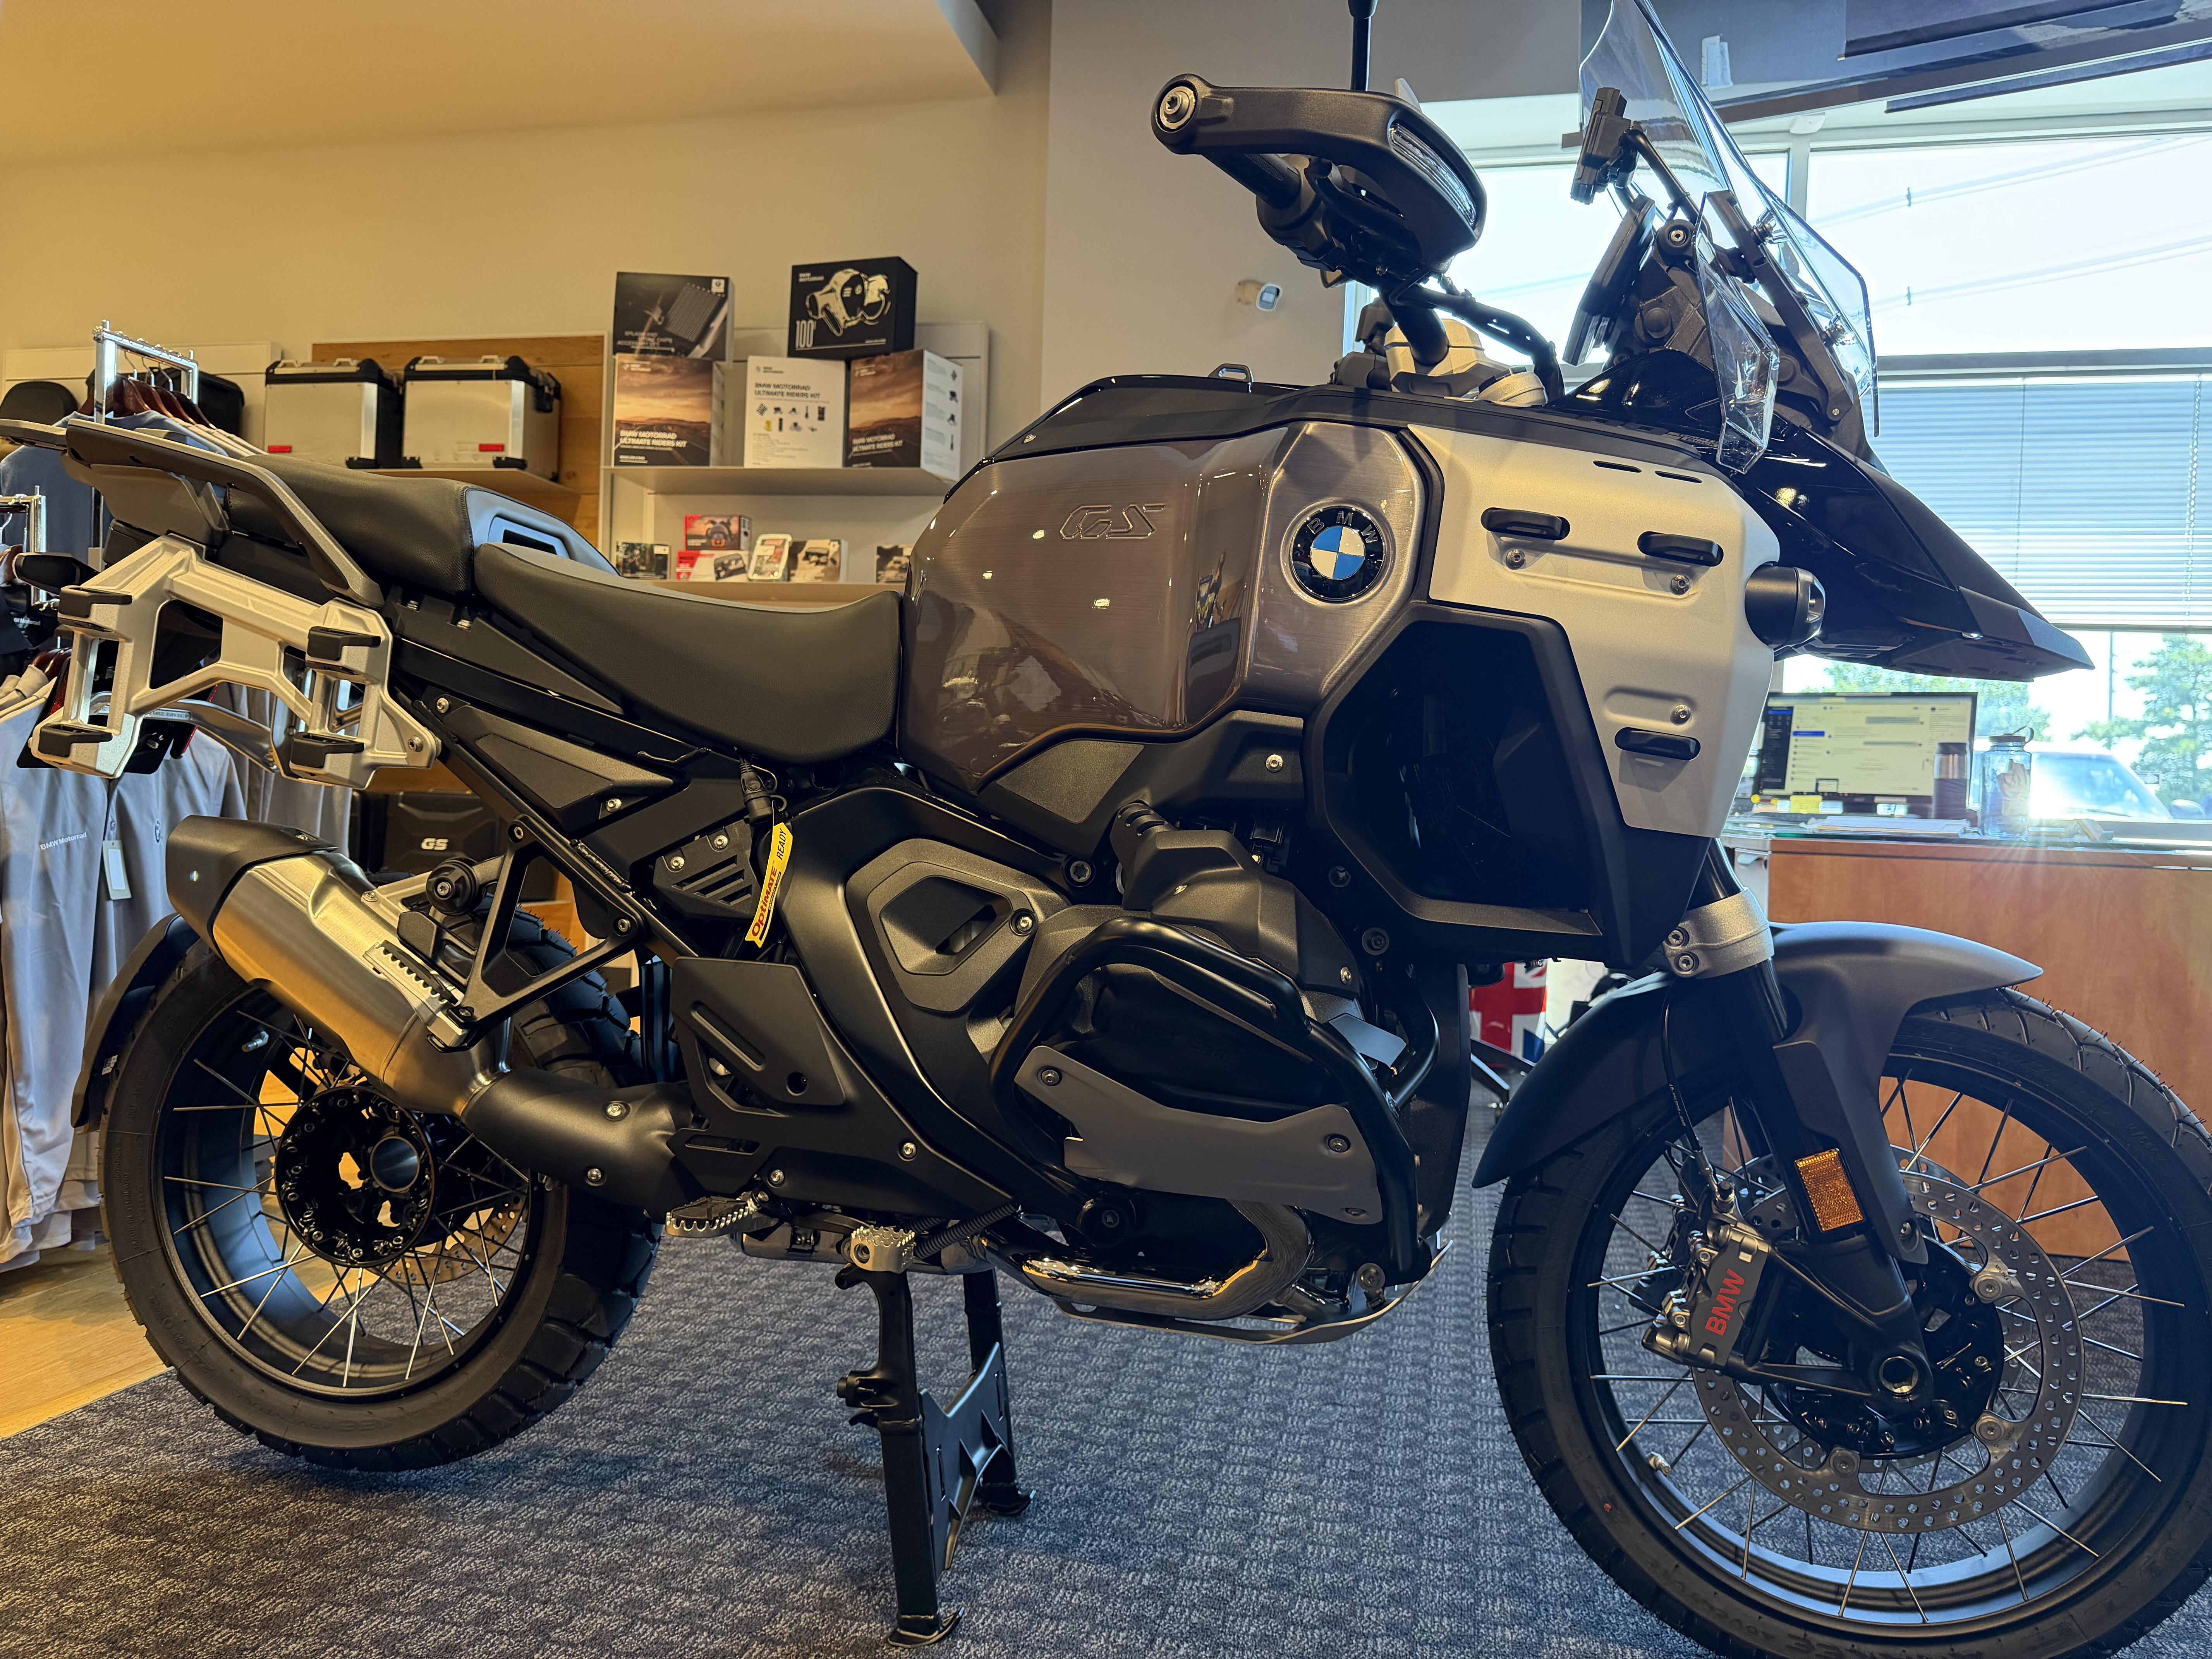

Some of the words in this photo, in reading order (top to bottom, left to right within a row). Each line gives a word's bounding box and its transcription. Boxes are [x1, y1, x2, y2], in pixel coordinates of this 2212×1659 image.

[620, 437, 651, 446] ULTIMATE
[652, 439, 675, 447] RIDERS
[638, 431, 677, 440] MOTORRAD
[866, 433, 896, 443] MOTORRAD
[1060, 503, 1166, 540] GS
[1307, 510, 1379, 544] BMW
[40, 839, 58, 850] BMW
[58, 831, 87, 844] Motorrad
[421, 838, 449, 850] GS
[776, 828, 787, 860] READY
[752, 865, 778, 937] OptiMATE
[1705, 1268, 1745, 1336] BMW
